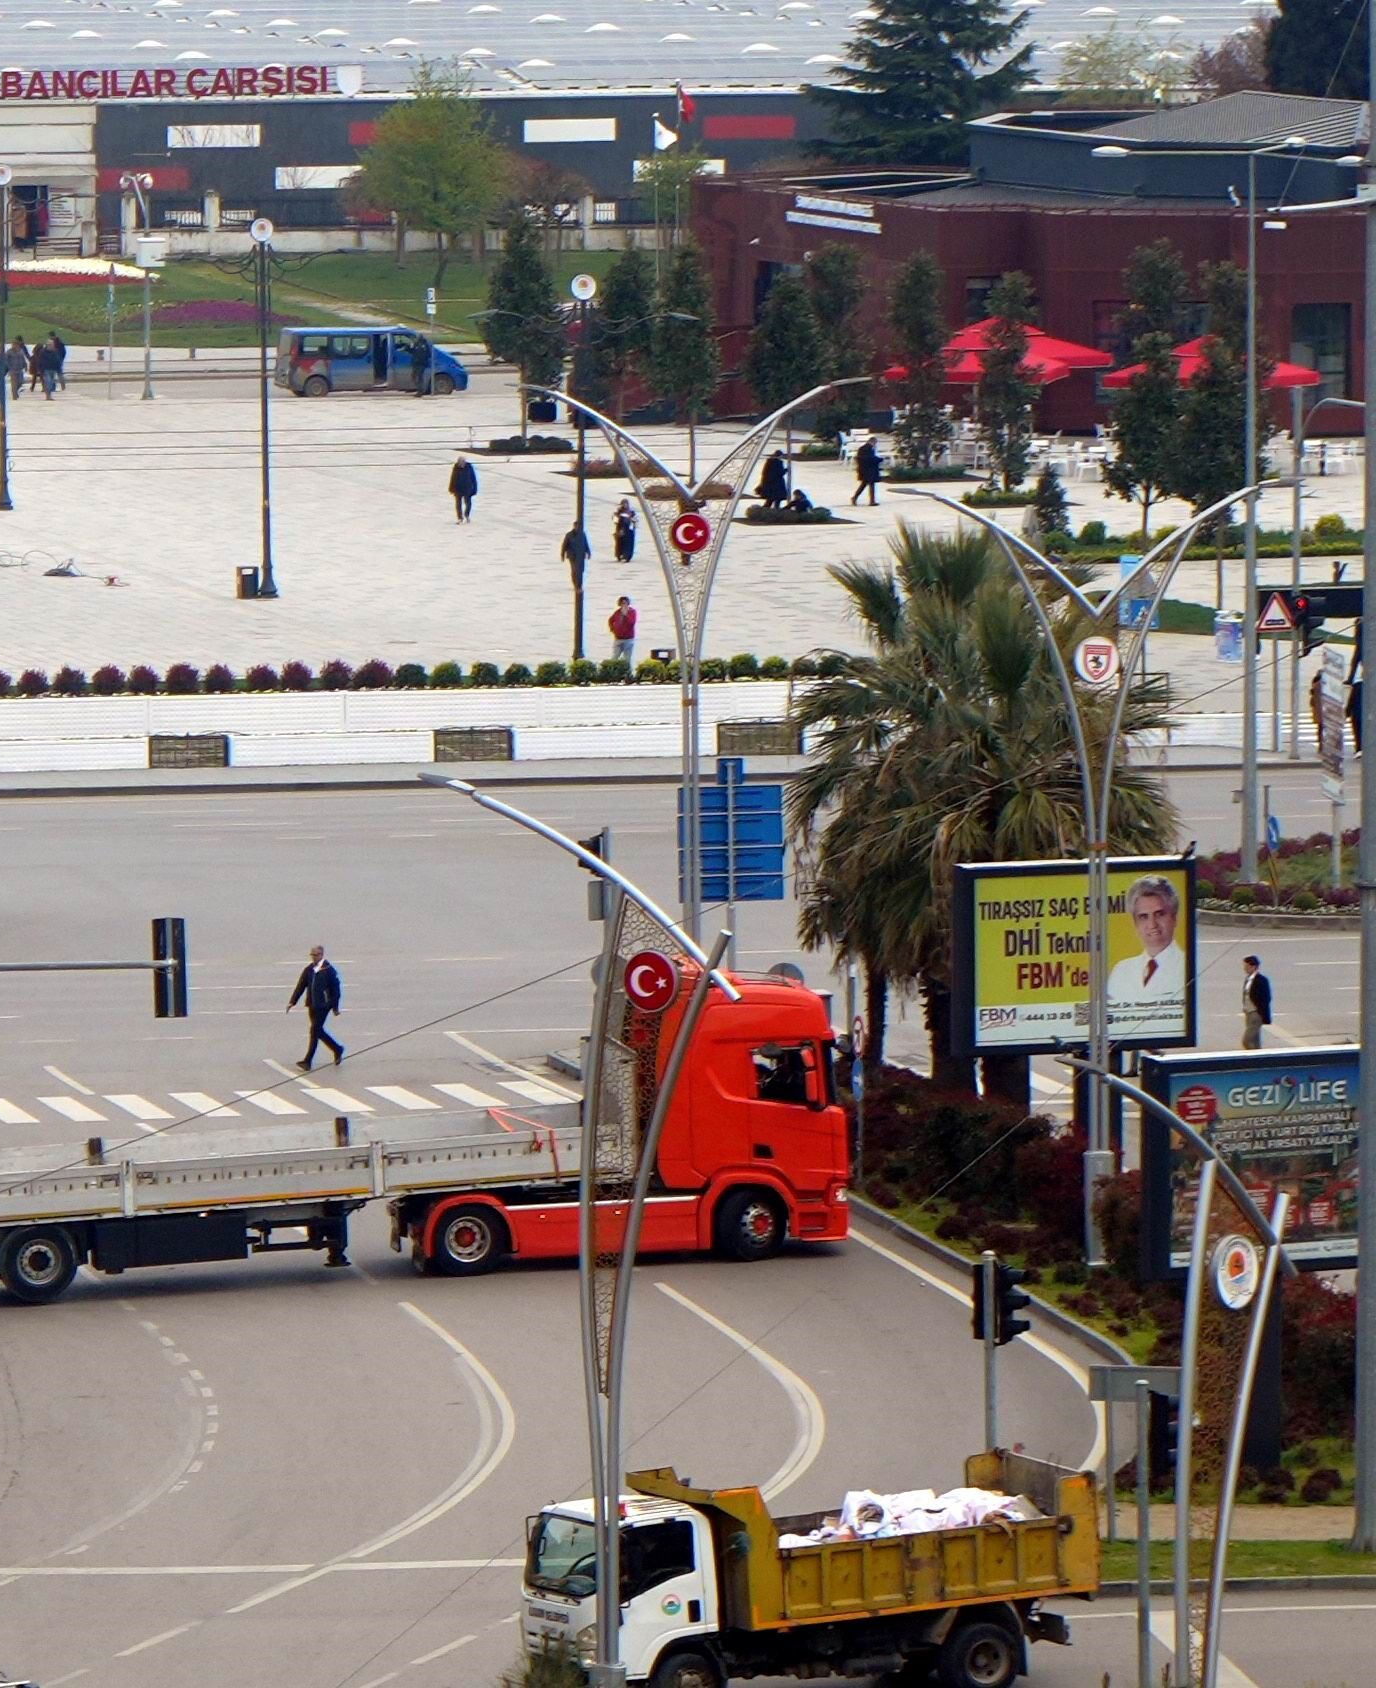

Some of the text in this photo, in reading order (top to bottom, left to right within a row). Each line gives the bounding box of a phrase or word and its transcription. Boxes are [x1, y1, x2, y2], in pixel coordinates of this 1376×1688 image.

[186, 65, 328, 100] ÇARŞISI
[978, 891, 1127, 923] TIRAŞSIZ SAÇ EMİ
[1004, 923, 1041, 957] DHİ
[980, 1008, 1017, 1022] FBM
[1026, 1013, 1045, 1021] 444
